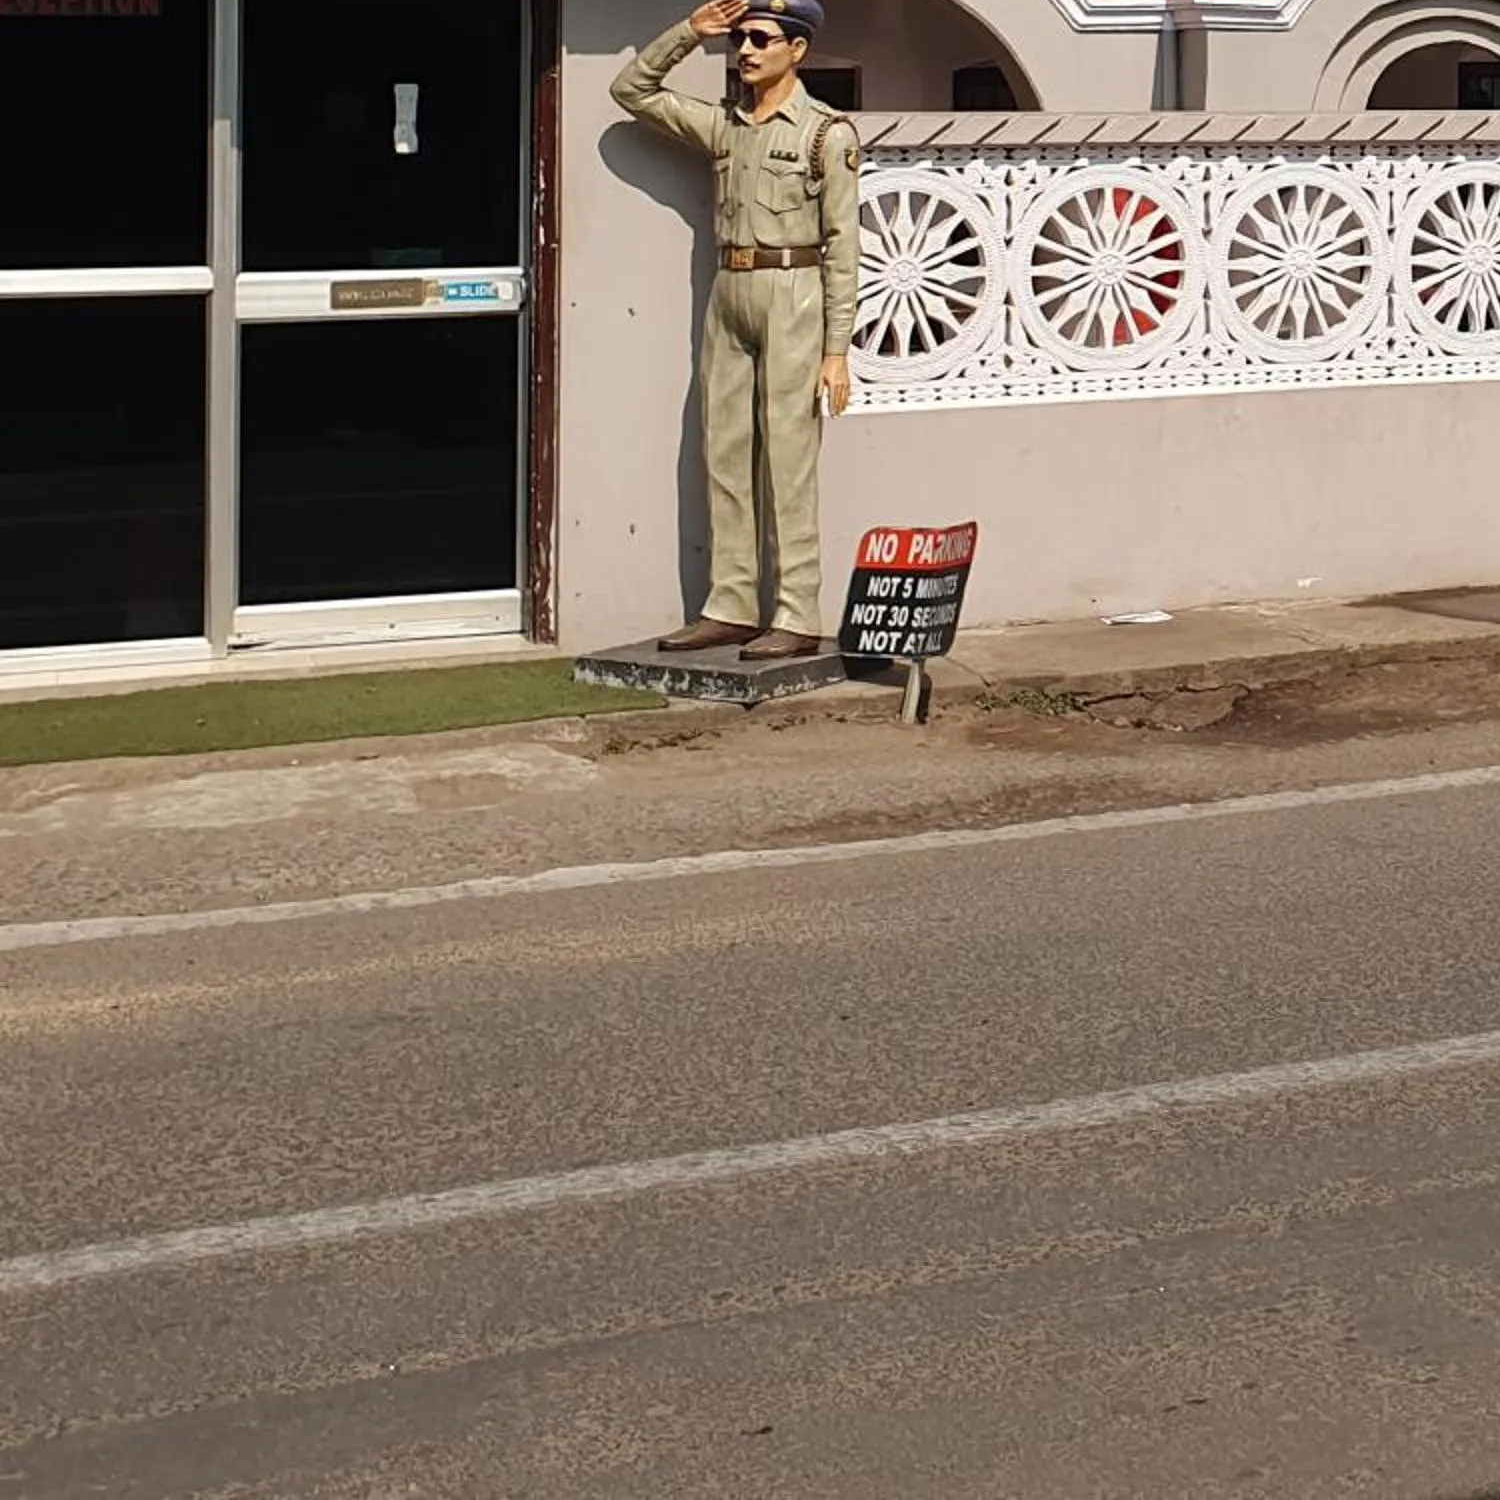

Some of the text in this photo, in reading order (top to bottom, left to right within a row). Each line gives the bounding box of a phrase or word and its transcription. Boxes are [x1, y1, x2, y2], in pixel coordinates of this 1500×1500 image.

[865, 528, 974, 564] NO PARKING
[867, 574, 959, 599] NOT 5 MINUTES
[851, 603, 957, 628] NOT 30 SECONDS
[858, 630, 943, 653] NOT AT ALL
